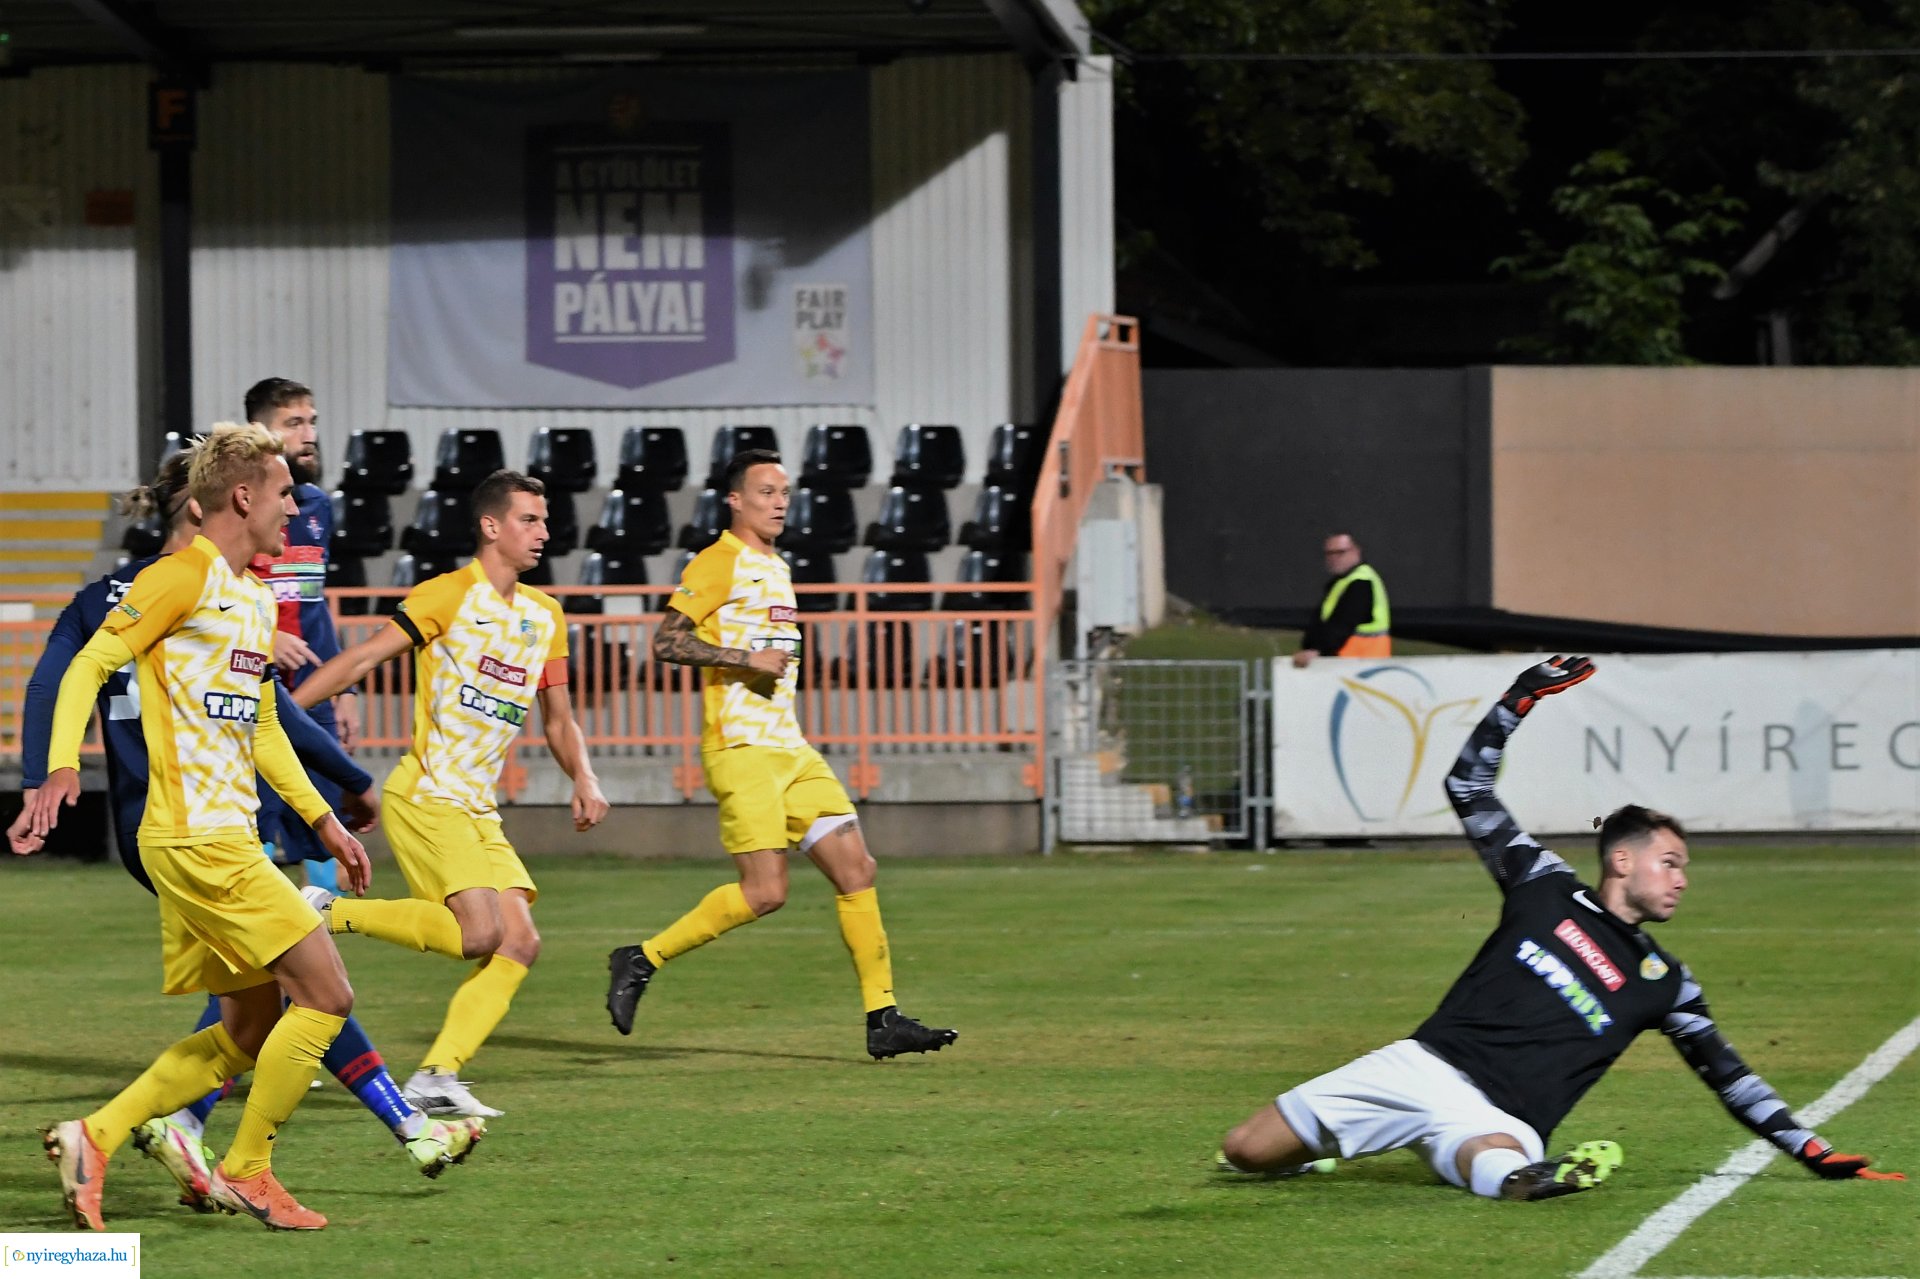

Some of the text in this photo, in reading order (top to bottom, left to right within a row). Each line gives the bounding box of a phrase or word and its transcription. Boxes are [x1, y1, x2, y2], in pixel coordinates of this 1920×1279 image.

[156, 88, 188, 129] F
[556, 159, 574, 188] A
[554, 192, 705, 271] NEM
[554, 271, 705, 334] PÁLYA!
[796, 289, 844, 308] FAIR
[796, 311, 844, 329] PLAY
